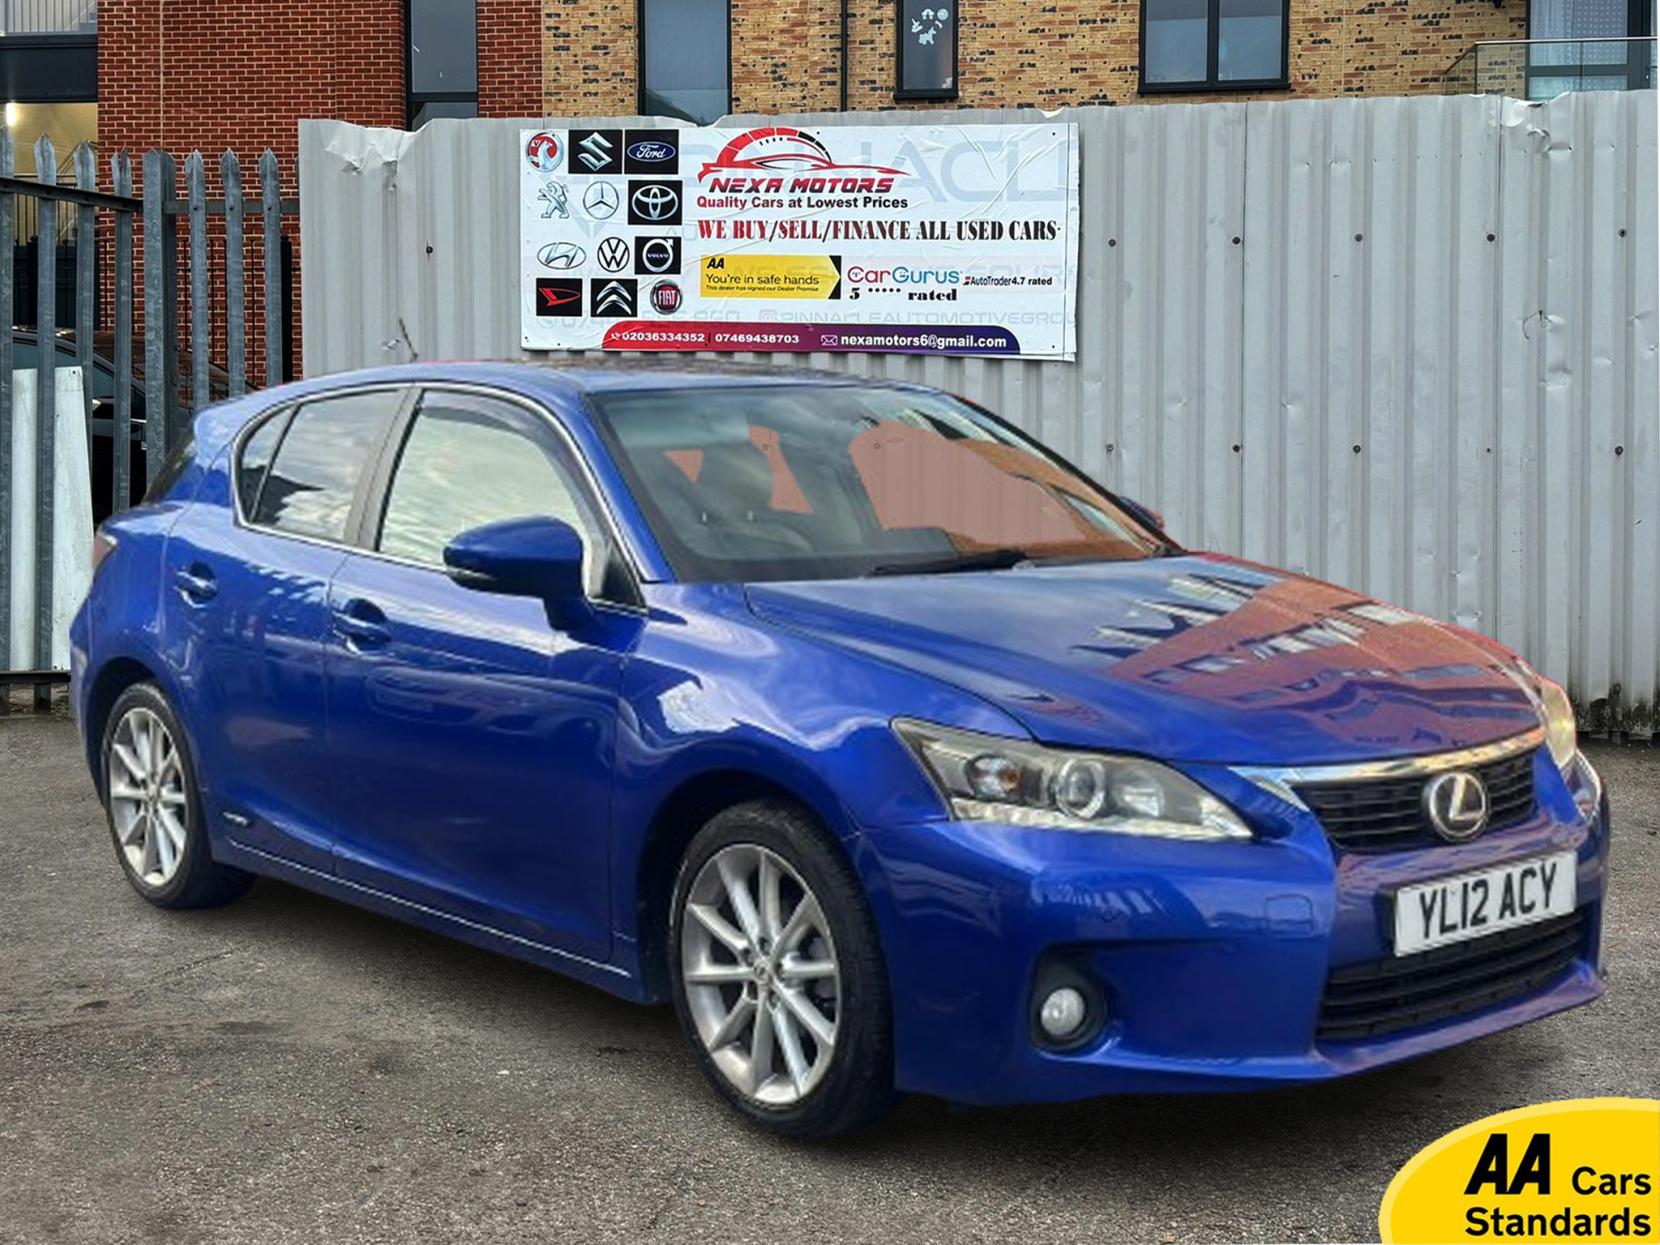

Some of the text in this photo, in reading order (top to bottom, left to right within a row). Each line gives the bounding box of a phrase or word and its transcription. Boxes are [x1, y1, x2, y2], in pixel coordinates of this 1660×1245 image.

[636, 144, 667, 159] Ford
[709, 178, 895, 194] NEXA MOTORS
[697, 195, 909, 210] Quality Cars at Lowest Prices
[697, 219, 727, 240] WE
[732, 220, 911, 242] BUY/SELL/FINANCE
[916, 220, 951, 241] ALL
[957, 220, 1004, 241] USED
[1009, 220, 1057, 241] CARS
[706, 257, 725, 269] AA
[705, 273, 820, 285] You're in safe hands
[847, 266, 960, 284] CarGurus
[1028, 276, 1053, 286] rated
[658, 290, 677, 306] FIAT
[849, 287, 958, 301] 5 rated
[621, 331, 800, 344] 02036334352 07469438703
[840, 333, 1008, 350] nexamotors6@gmail.com
[1418, 861, 1558, 940] YL12 ACY
